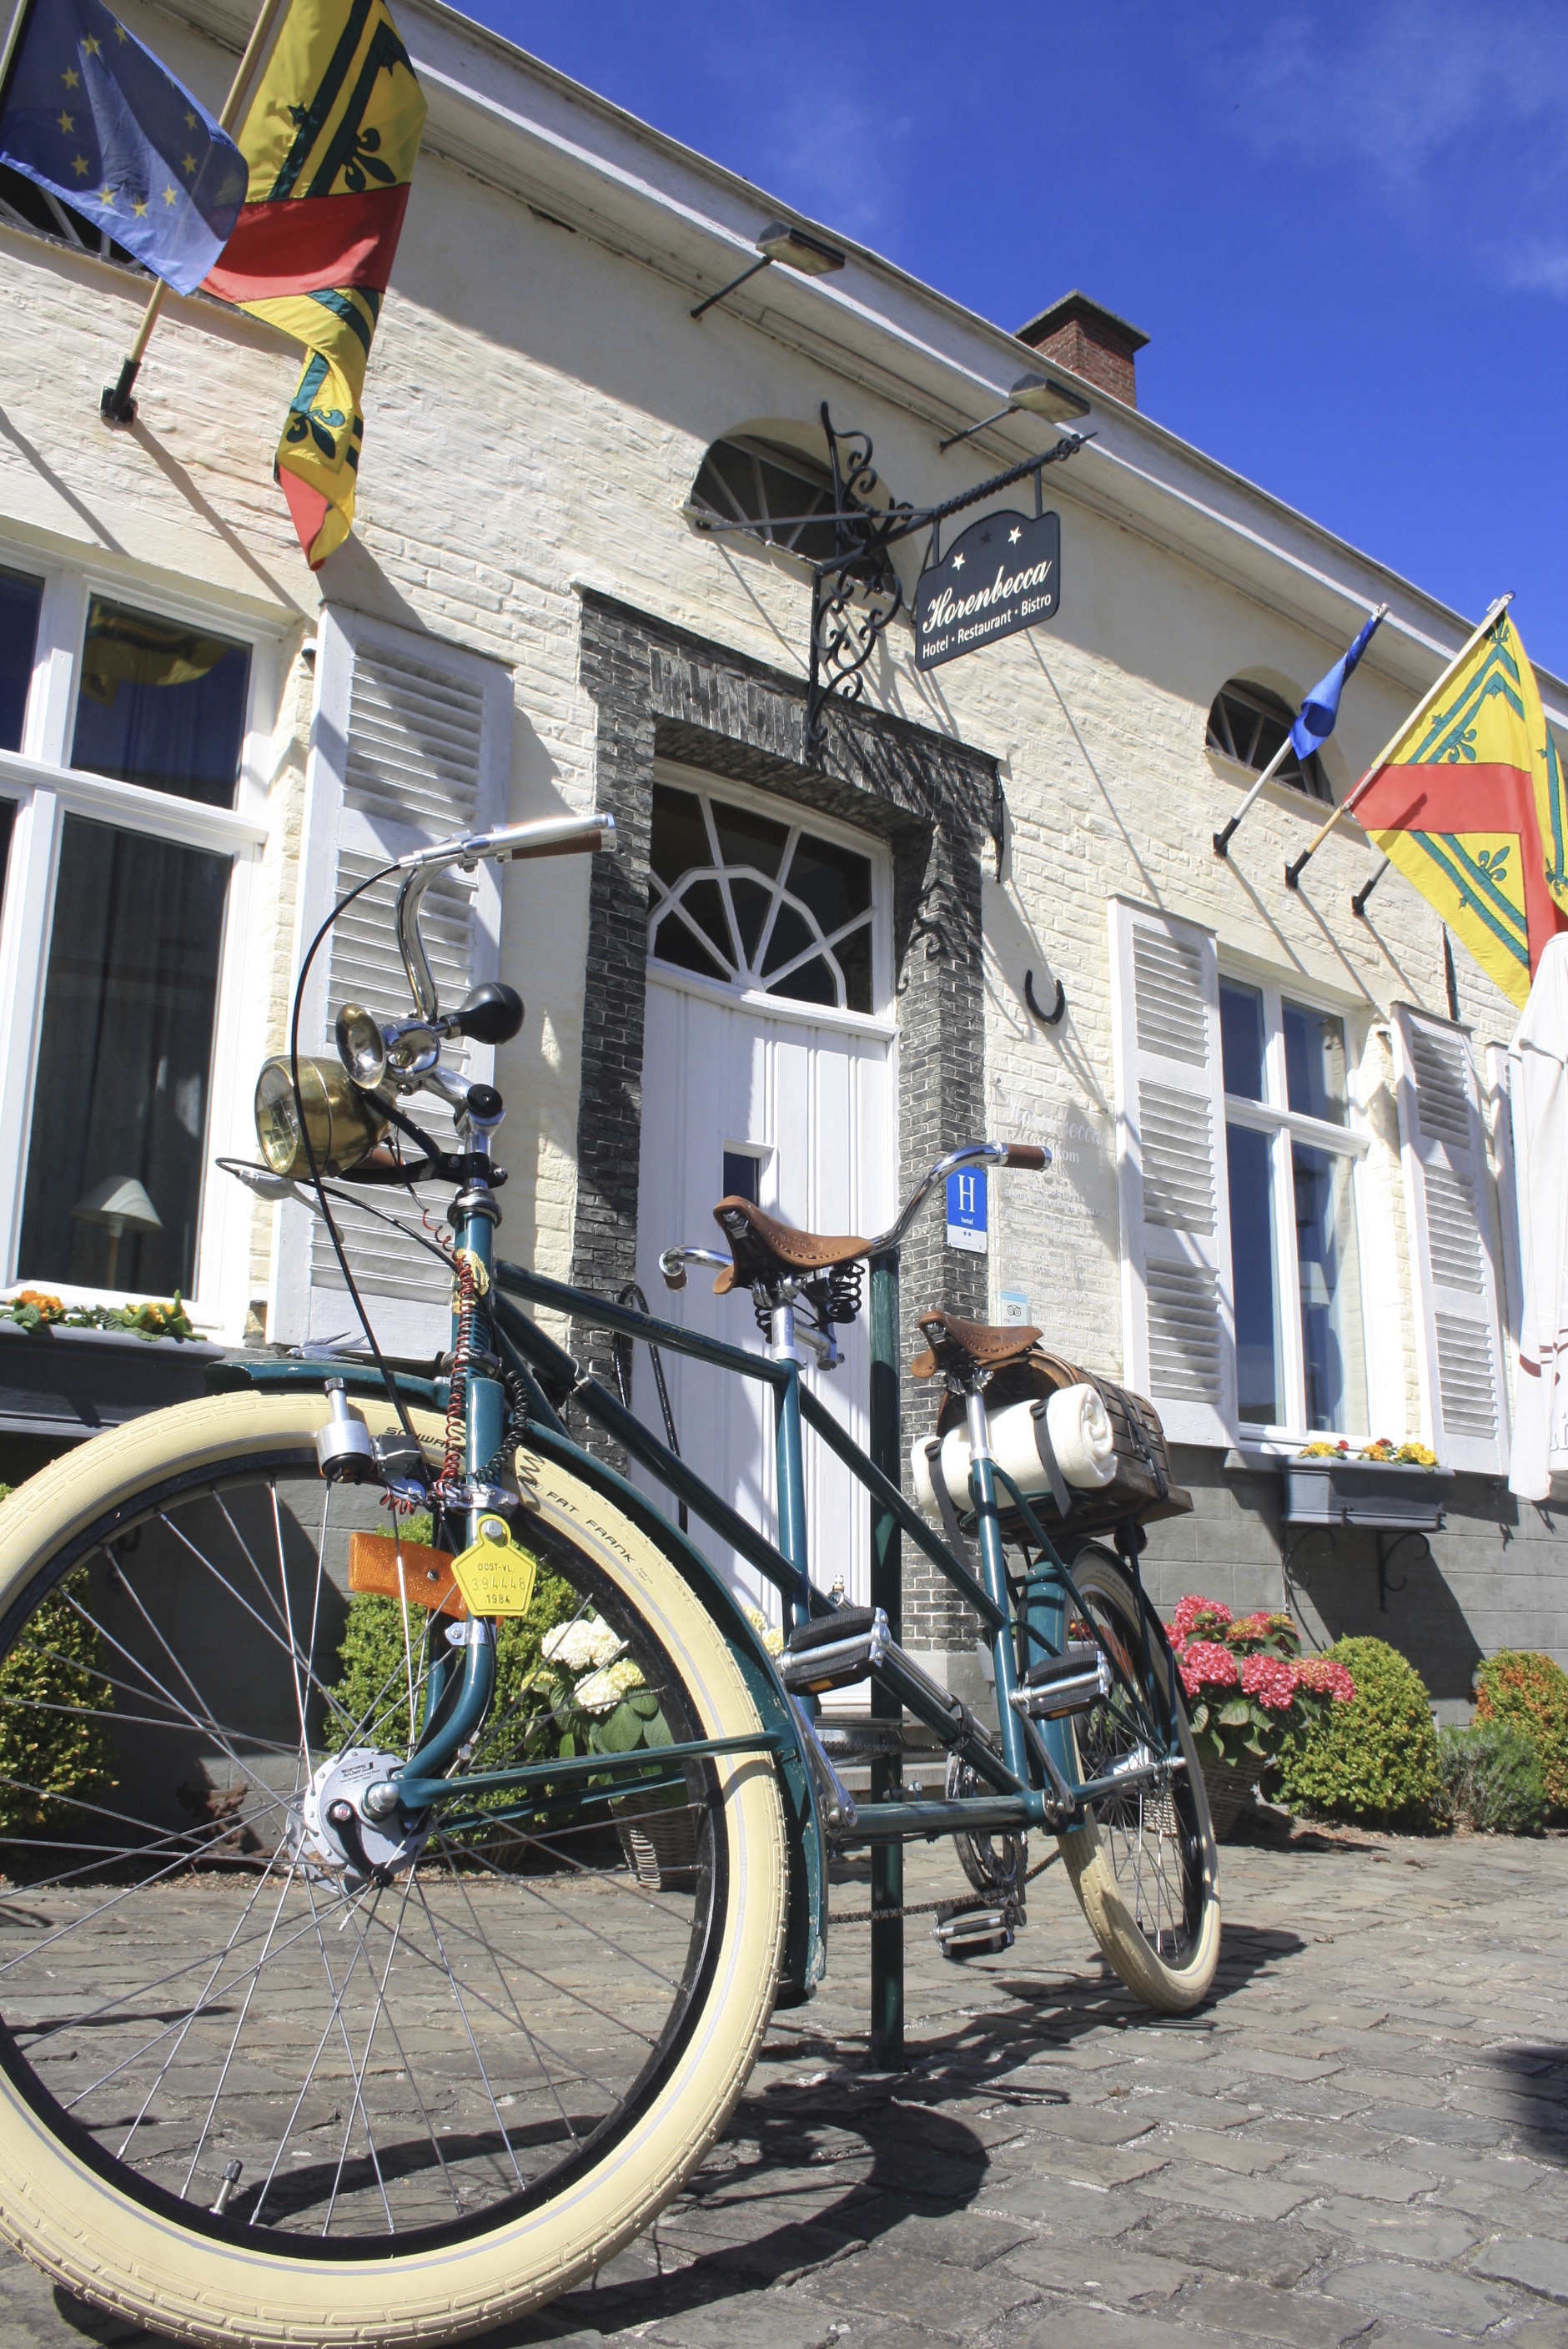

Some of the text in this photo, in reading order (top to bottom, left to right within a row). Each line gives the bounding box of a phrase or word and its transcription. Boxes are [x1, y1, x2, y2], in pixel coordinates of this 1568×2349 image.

[922, 560, 1053, 634] Horenbecca
[922, 594, 1052, 659] Hotel Restaurant Bistro
[957, 1174, 975, 1213] H
[961, 1216, 973, 1225] hotel
[546, 1491, 636, 1565] FAT FRANK
